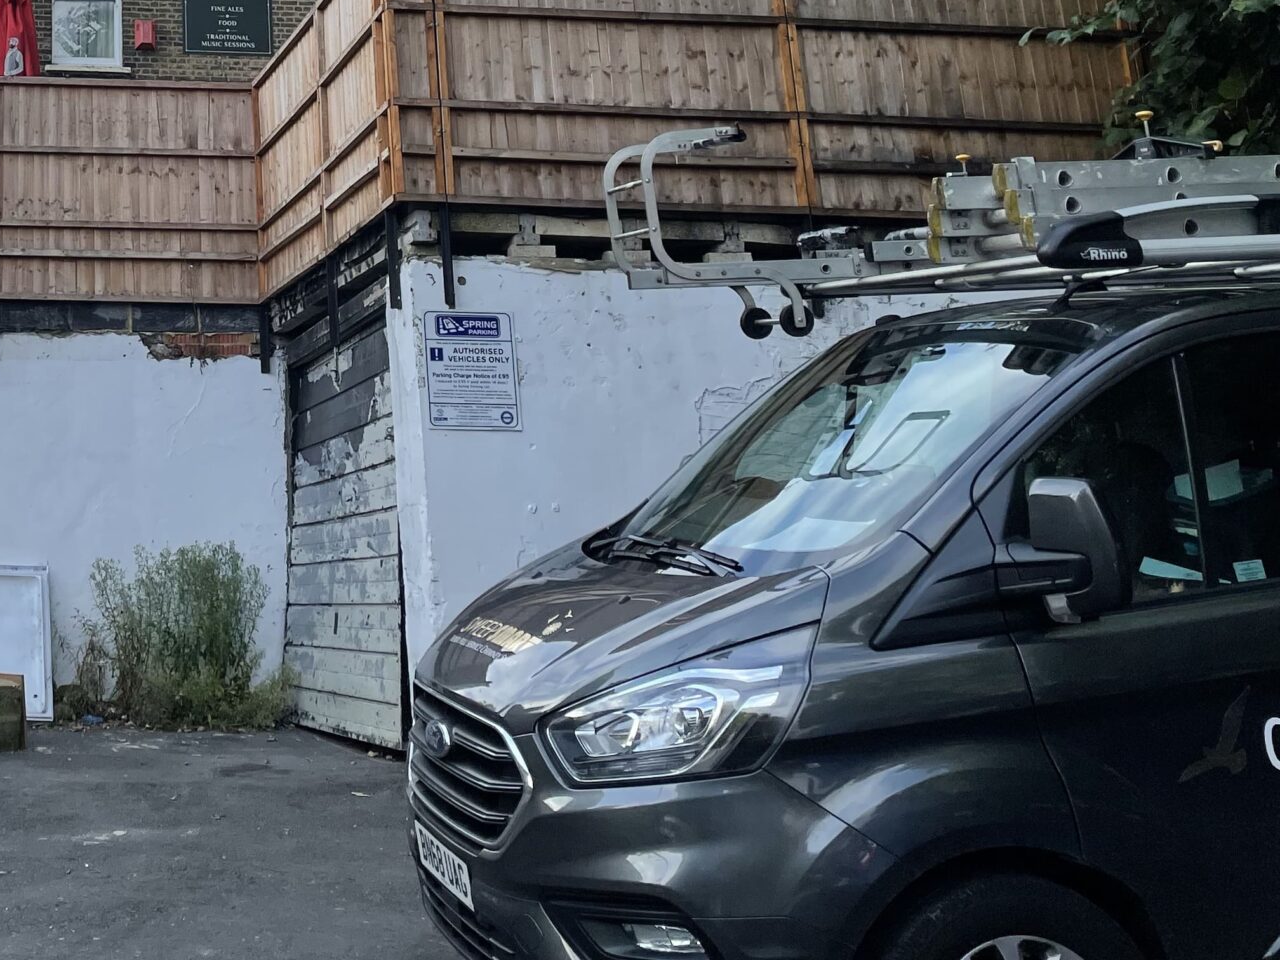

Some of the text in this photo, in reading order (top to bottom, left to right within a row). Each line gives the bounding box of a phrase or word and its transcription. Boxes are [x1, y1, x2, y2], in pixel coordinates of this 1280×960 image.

[206, 33, 250, 41] TRADITIONAL
[224, 41, 256, 49] SESSIONS
[1089, 248, 1128, 261] Rhino
[463, 320, 497, 329] SPRING
[453, 347, 504, 356] AUTHORISED
[448, 355, 510, 364] VEHICLES ONLY
[418, 828, 446, 878] BN68
